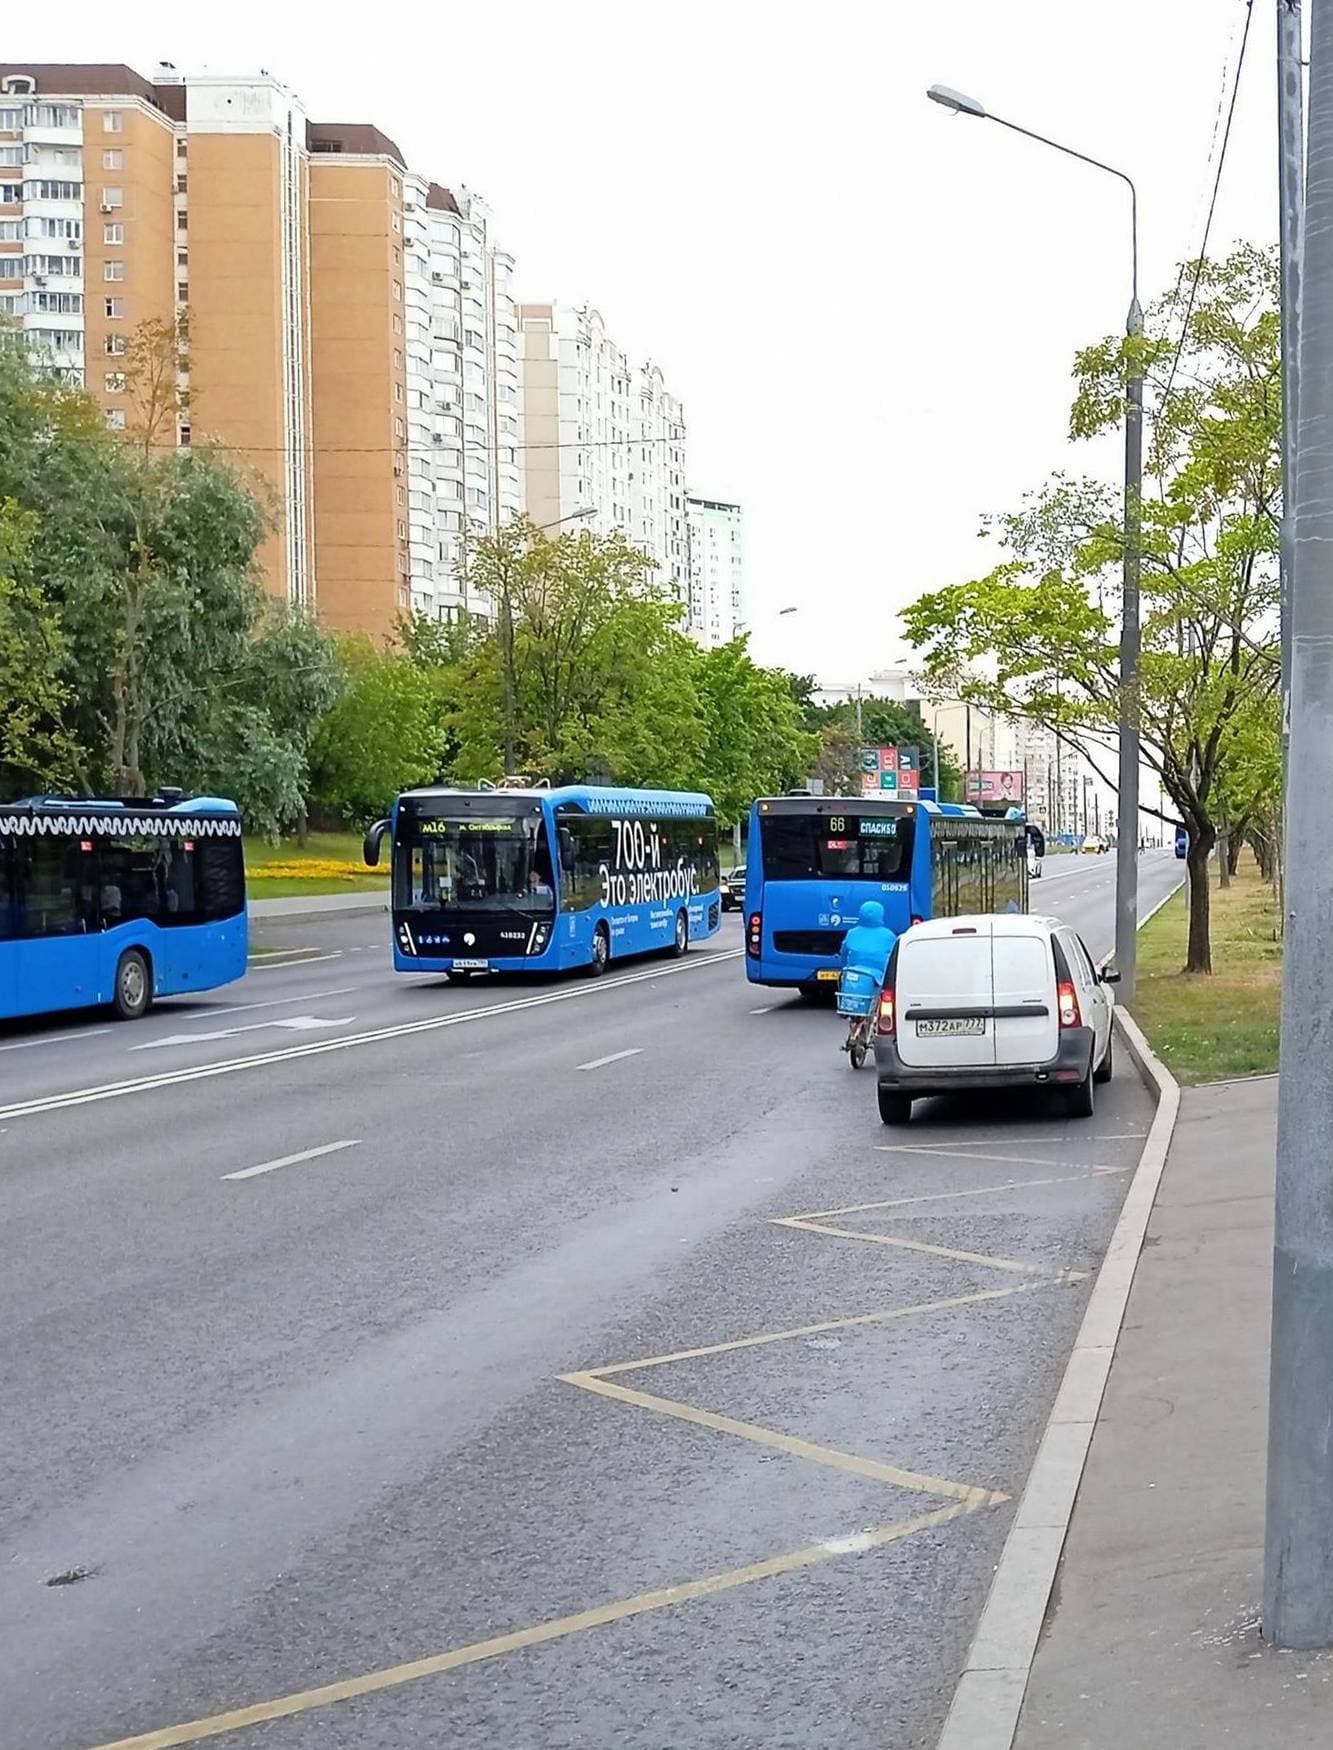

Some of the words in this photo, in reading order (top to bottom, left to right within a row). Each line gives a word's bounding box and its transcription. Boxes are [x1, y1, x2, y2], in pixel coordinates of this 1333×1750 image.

[611, 820, 660, 870] 700-й
[830, 817, 845, 832] 66
[860, 822, 896, 834] СПАСИБО
[599, 863, 626, 908] Это
[629, 857, 700, 909] электробус.
